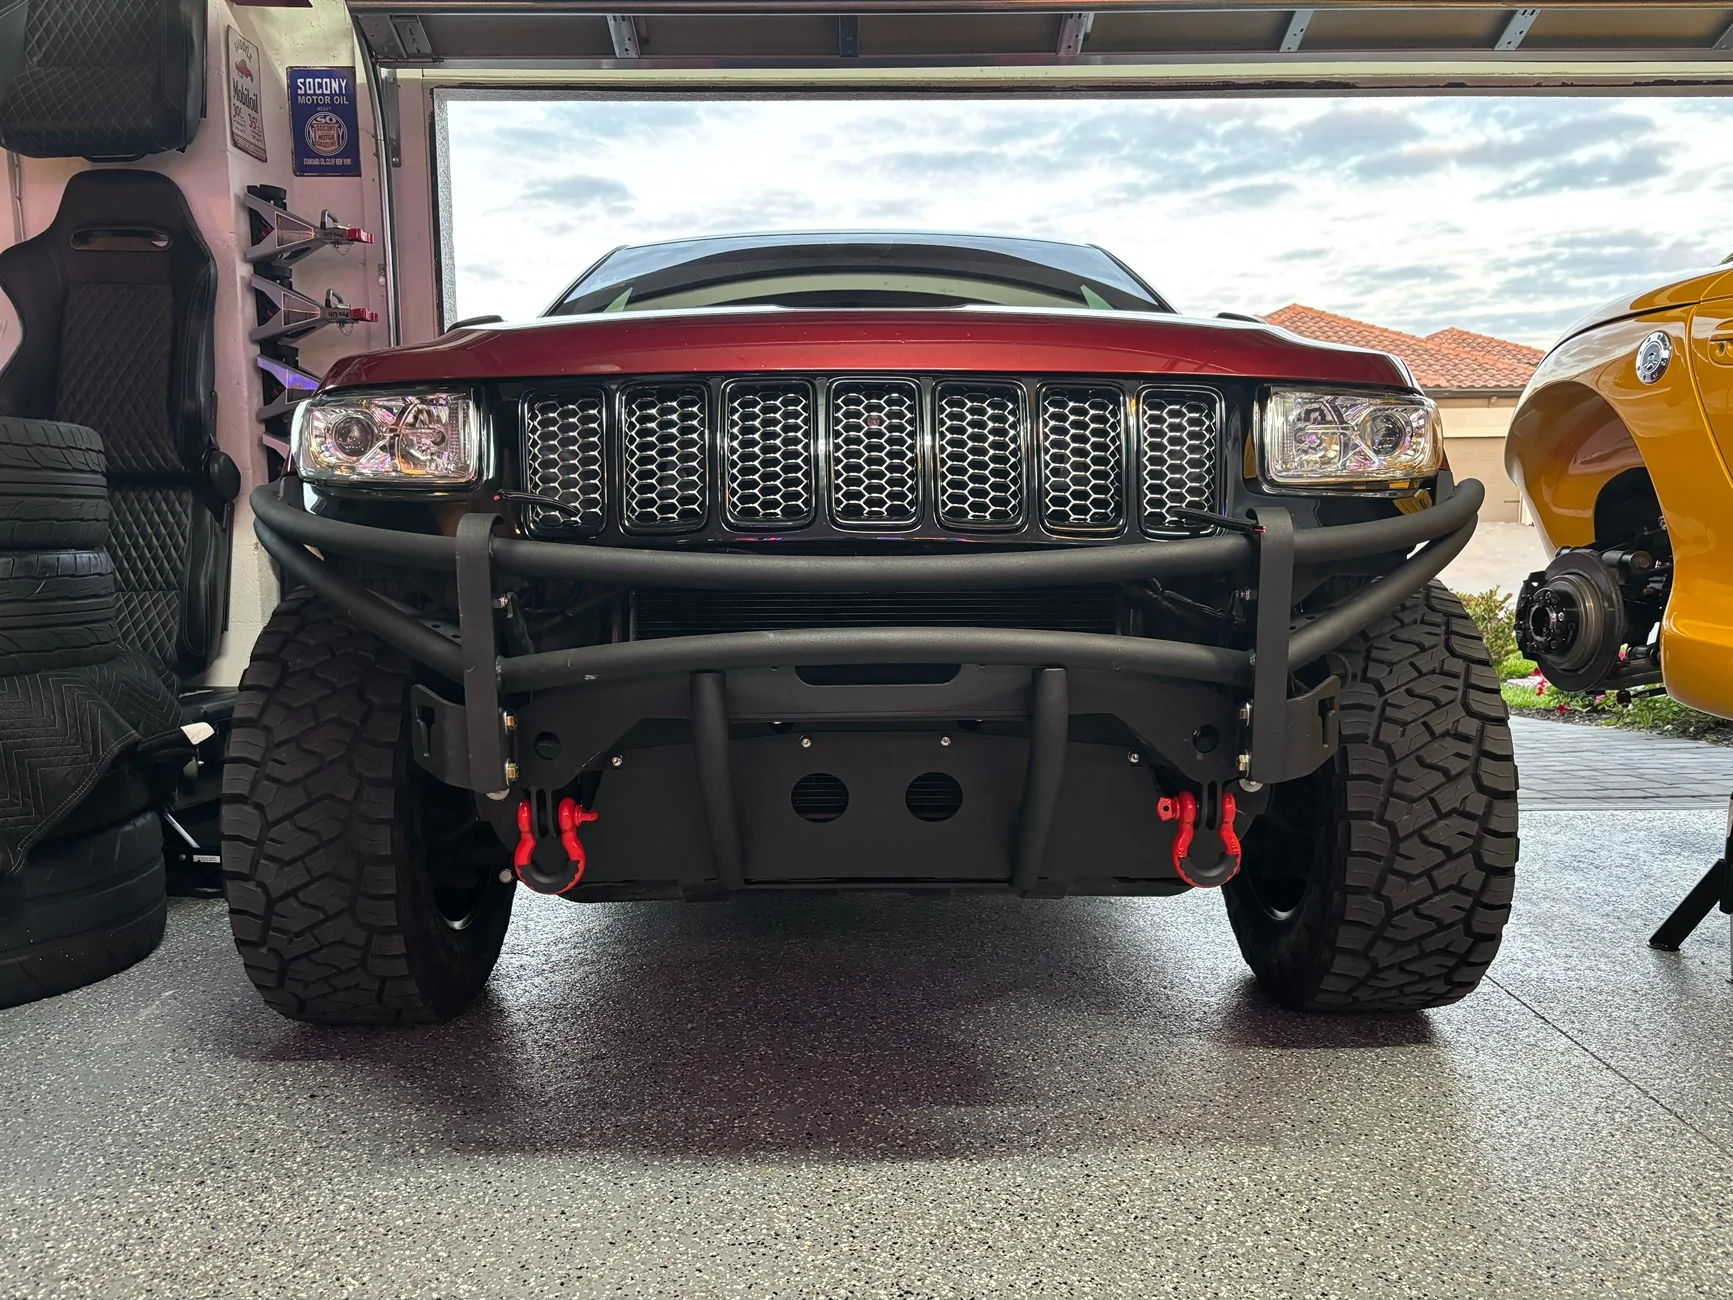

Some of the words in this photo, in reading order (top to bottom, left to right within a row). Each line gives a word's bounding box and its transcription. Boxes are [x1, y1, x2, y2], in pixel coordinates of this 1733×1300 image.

[297, 78, 347, 94] SOCONY
[298, 96, 331, 104] MOTOR
[334, 96, 349, 104] OIL
